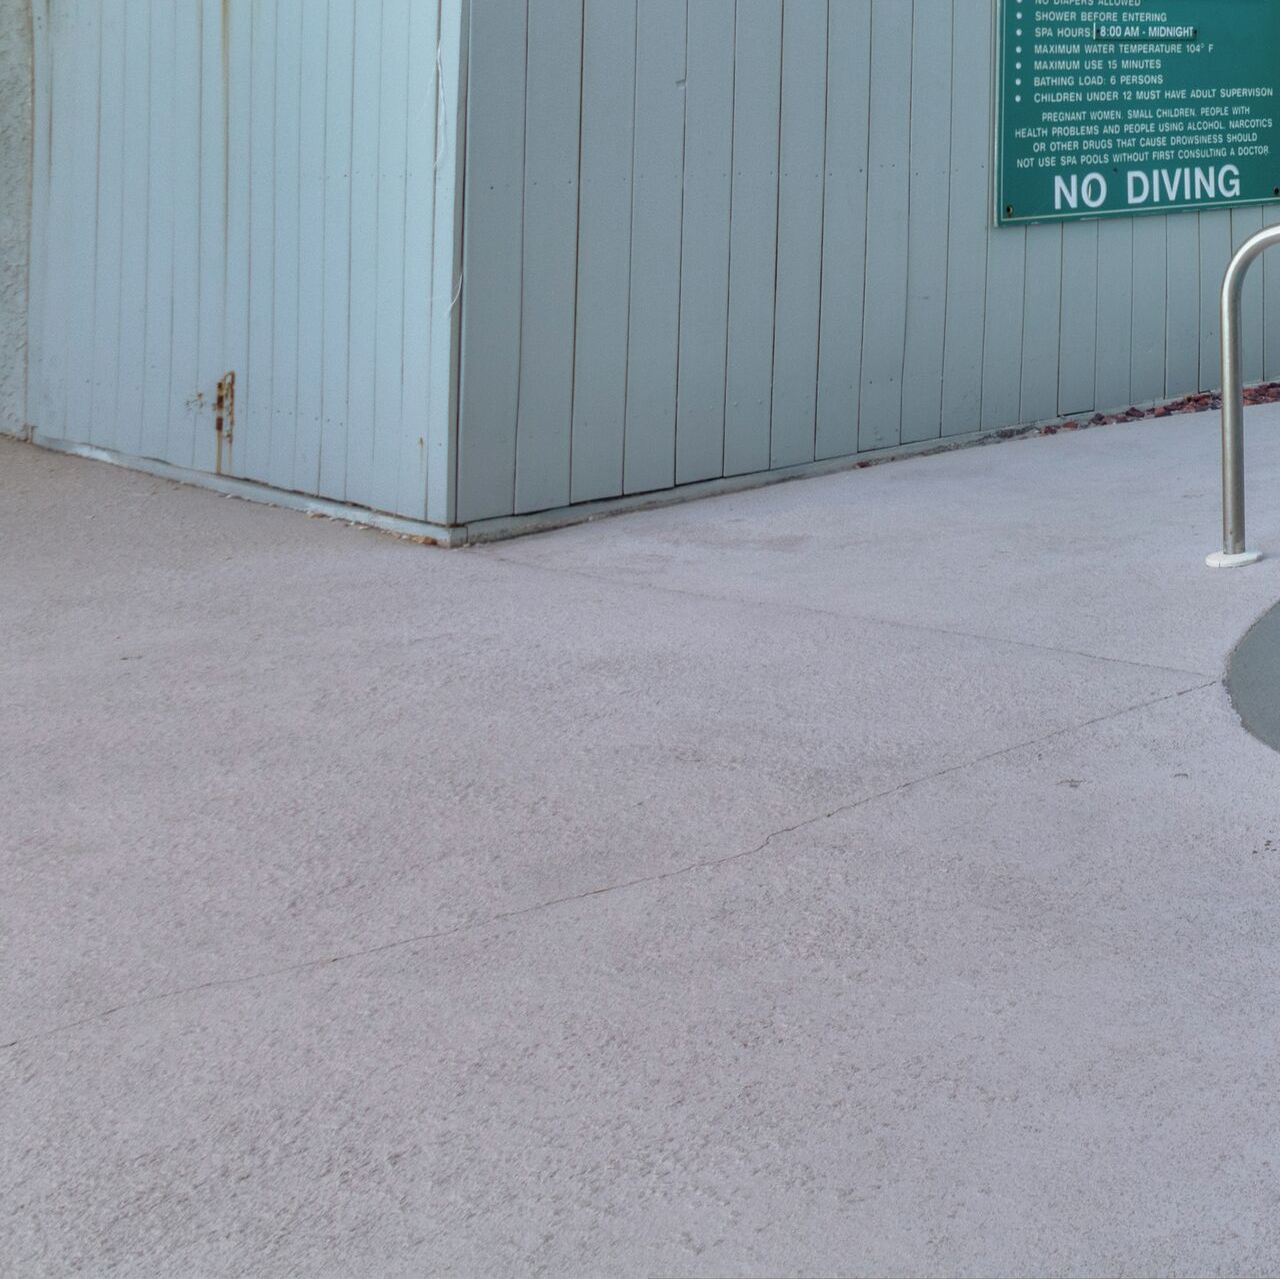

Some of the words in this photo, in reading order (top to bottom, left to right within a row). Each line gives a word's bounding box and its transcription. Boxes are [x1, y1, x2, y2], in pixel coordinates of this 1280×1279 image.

[1035, 11, 1076, 21] SHOWER
[1081, 11, 1118, 21] BEFORE
[1122, 12, 1167, 22] ENTERING
[1035, 27, 1053, 37] SPA
[1100, 26, 1121, 37] 8:00
[1125, 26, 1139, 37] AM
[1148, 26, 1194, 37] MIDNIGHT
[1034, 44, 1080, 54] MAXIMUM
[1085, 44, 1115, 53] WATER
[1119, 44, 1182, 53] TEMPERATURE
[1209, 44, 1214, 53] F
[1034, 60, 1080, 70] MAXIMUM
[1084, 60, 1103, 69] USE
[1108, 60, 1117, 69] 15
[1121, 60, 1161, 69] MINUTES
[1034, 76, 1074, 86] BATHING
[1078, 76, 1106, 85] LOAD:
[1110, 76, 1116, 85] 6
[1120, 75, 1163, 84] PERSONS
[1034, 93, 1082, 103] CHILDREN
[1087, 92, 1118, 101] UNDER
[1123, 91, 1131, 100] 12
[1136, 90, 1160, 100] MUST
[1164, 90, 1186, 99] HAVE
[1190, 89, 1216, 98] ADULT
[1220, 87, 1273, 98] SUPERVISON
[1042, 111, 1087, 122] PREGNANT
[1127, 109, 1153, 119] SMALL
[1200, 107, 1228, 116] PEOPLE
[1232, 106, 1250, 115] WITH
[1015, 128, 1048, 138] HEALTH
[1052, 126, 1099, 137] PROBLEMS
[1103, 125, 1120, 134] AND
[1124, 123, 1155, 133] PEOPLE
[1159, 122, 1184, 132] USING
[1229, 119, 1273, 129] NARCOTICS
[1033, 142, 1046, 152] OR
[1049, 141, 1078, 151] OTHER
[1082, 139, 1112, 150] DRUGS
[1116, 138, 1136, 148] THAT
[1140, 136, 1167, 147] CAUSE
[1170, 135, 1223, 146] DROWSINESS
[1227, 133, 1257, 142] SHOULD
[1017, 158, 1034, 168] NOT
[1039, 157, 1056, 167] USE
[1060, 155, 1077, 165] SPA
[1081, 154, 1109, 164] POOLS
[1112, 152, 1149, 163] WITHOUT
[1152, 150, 1174, 160] FIRST
[1178, 148, 1227, 160] CONSULTING
[1230, 147, 1235, 156] A
[1054, 172, 1107, 210] NO
[1127, 164, 1240, 205] DIVING
